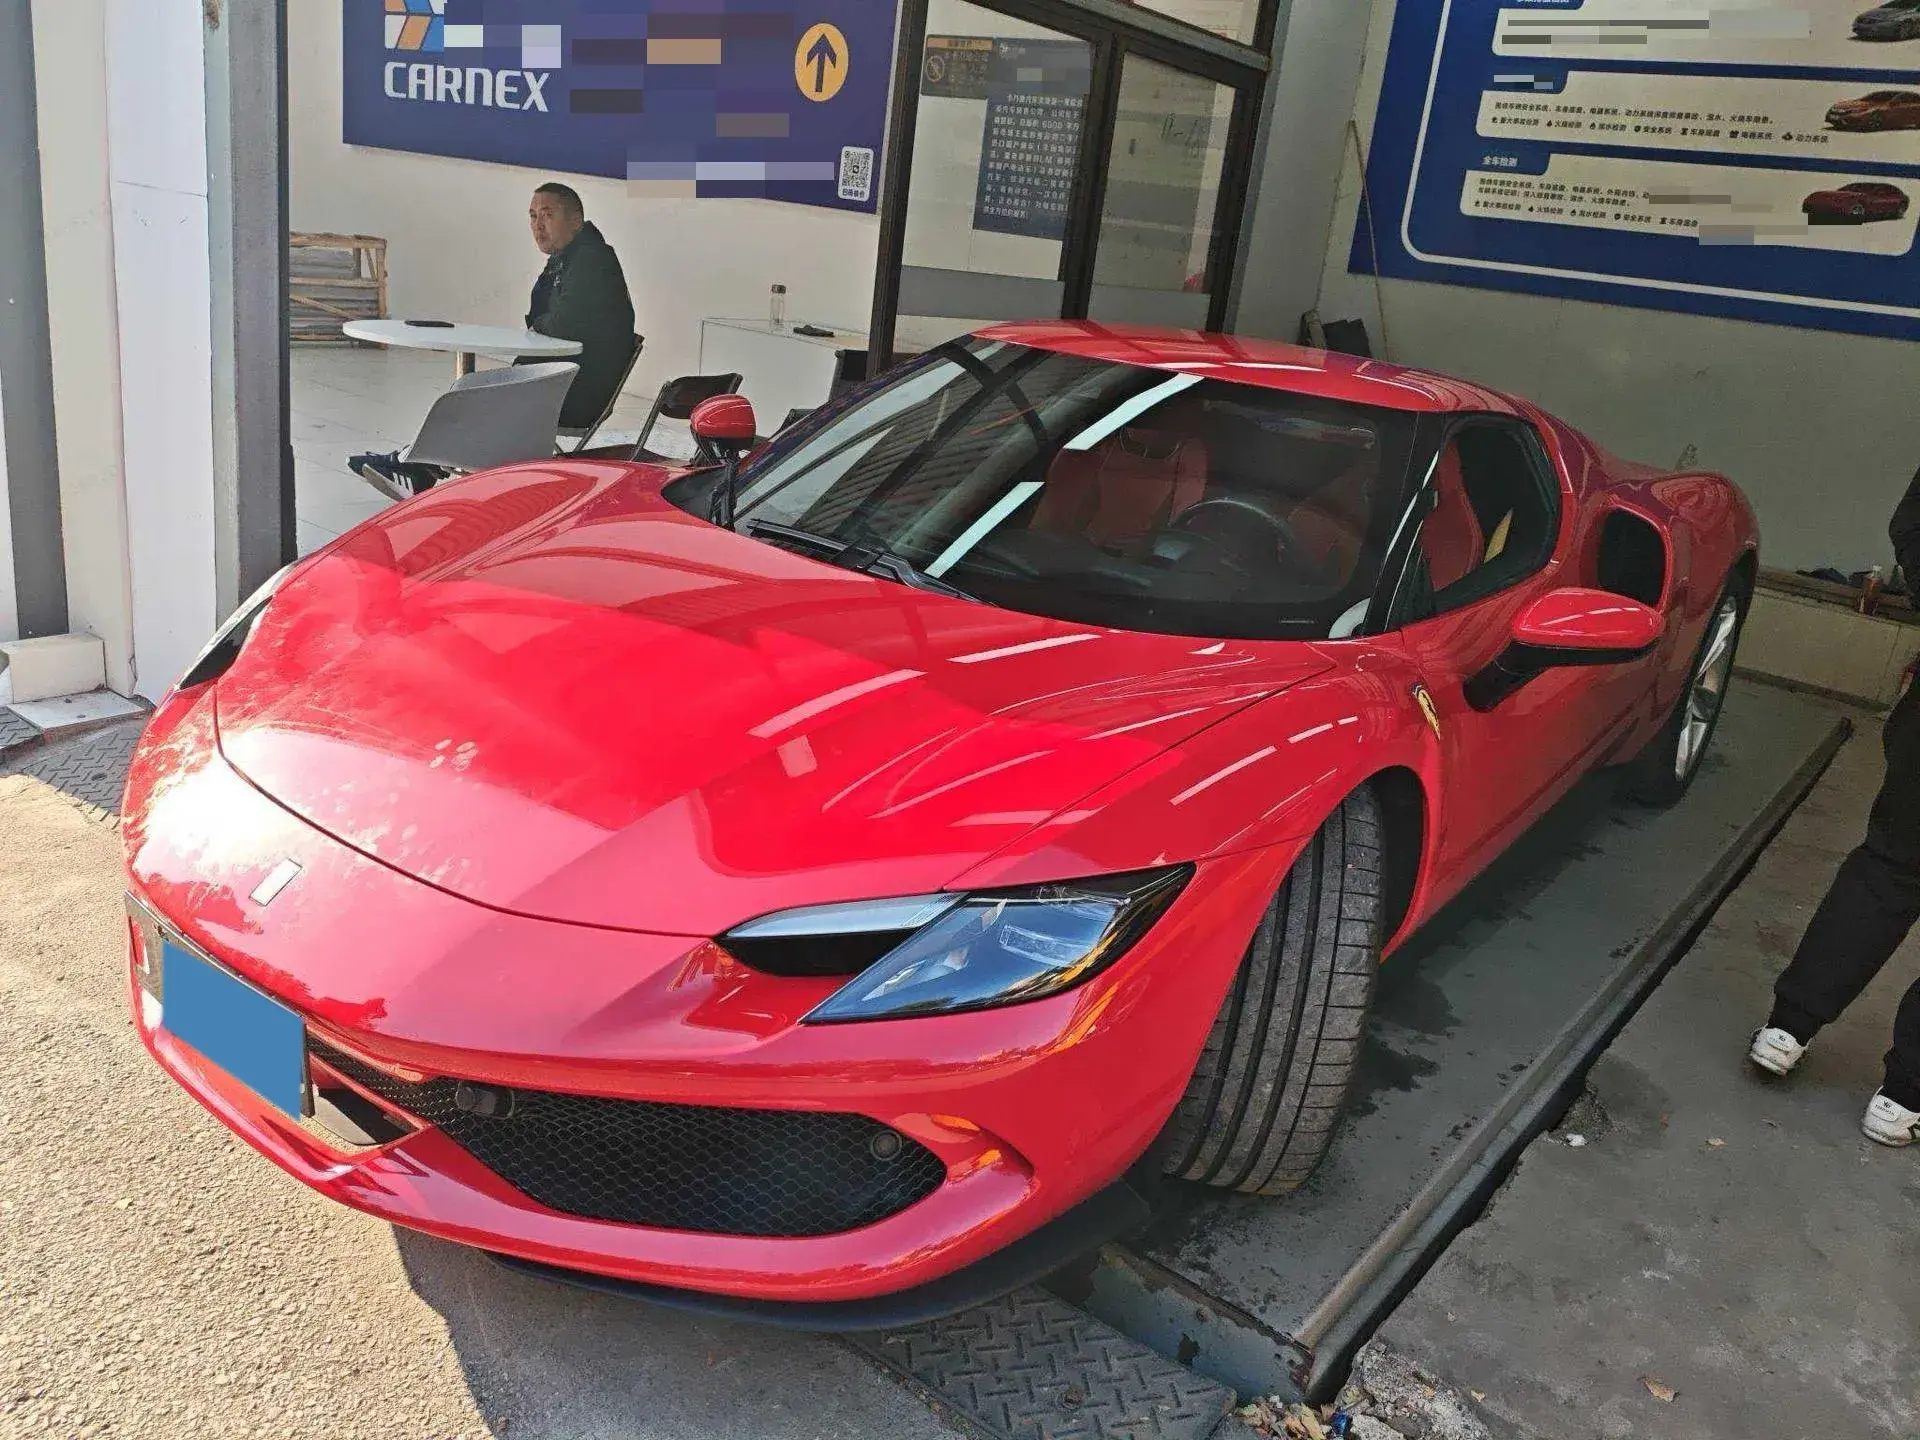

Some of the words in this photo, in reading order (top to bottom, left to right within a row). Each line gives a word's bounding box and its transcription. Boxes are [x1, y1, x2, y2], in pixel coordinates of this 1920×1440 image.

[384, 61, 550, 112] CARNEX
[1643, 125, 1673, 135] 安全系统
[1796, 133, 1829, 144] 动力系统
[1482, 155, 1518, 167] 全车检测
[1622, 213, 1652, 225] 安全系统
